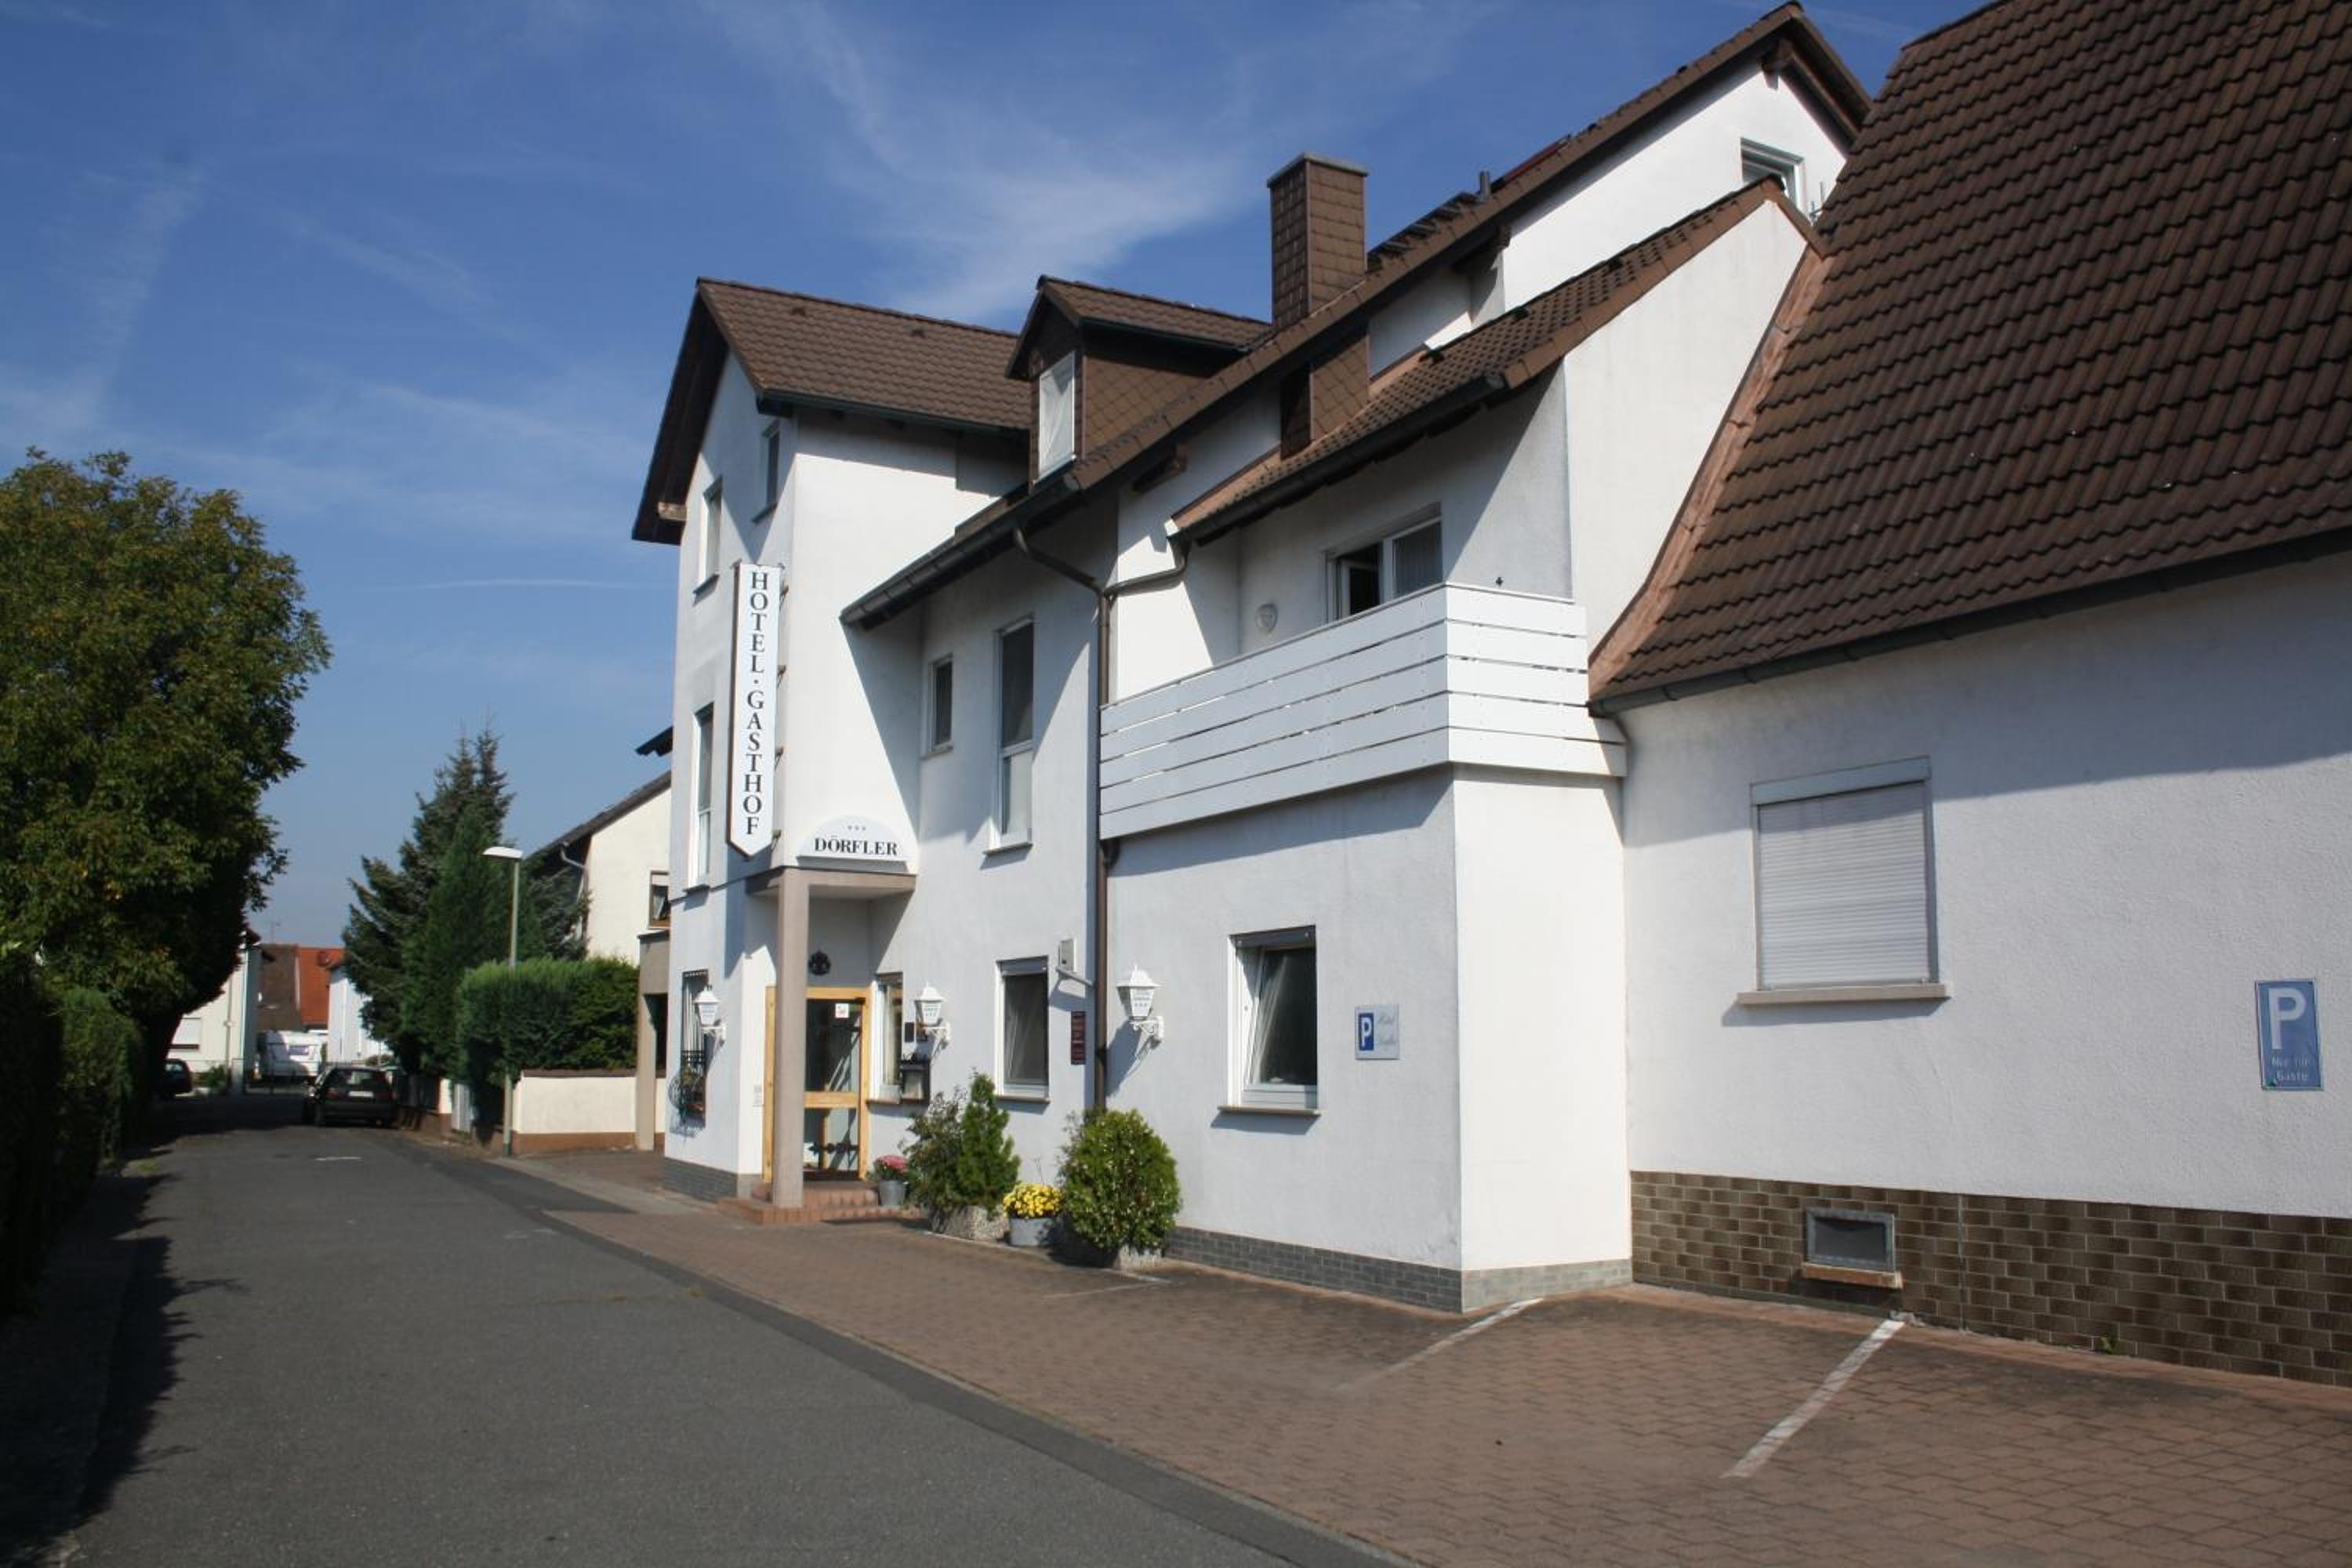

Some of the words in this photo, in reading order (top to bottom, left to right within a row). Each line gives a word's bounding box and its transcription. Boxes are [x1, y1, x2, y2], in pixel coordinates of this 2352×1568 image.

[750, 572, 768, 673] HOTEL
[742, 689, 764, 835] GASTHOF
[814, 835, 898, 856] DÖRFLER
[1360, 1017, 1373, 1048] P
[2268, 987, 2307, 1050] P
